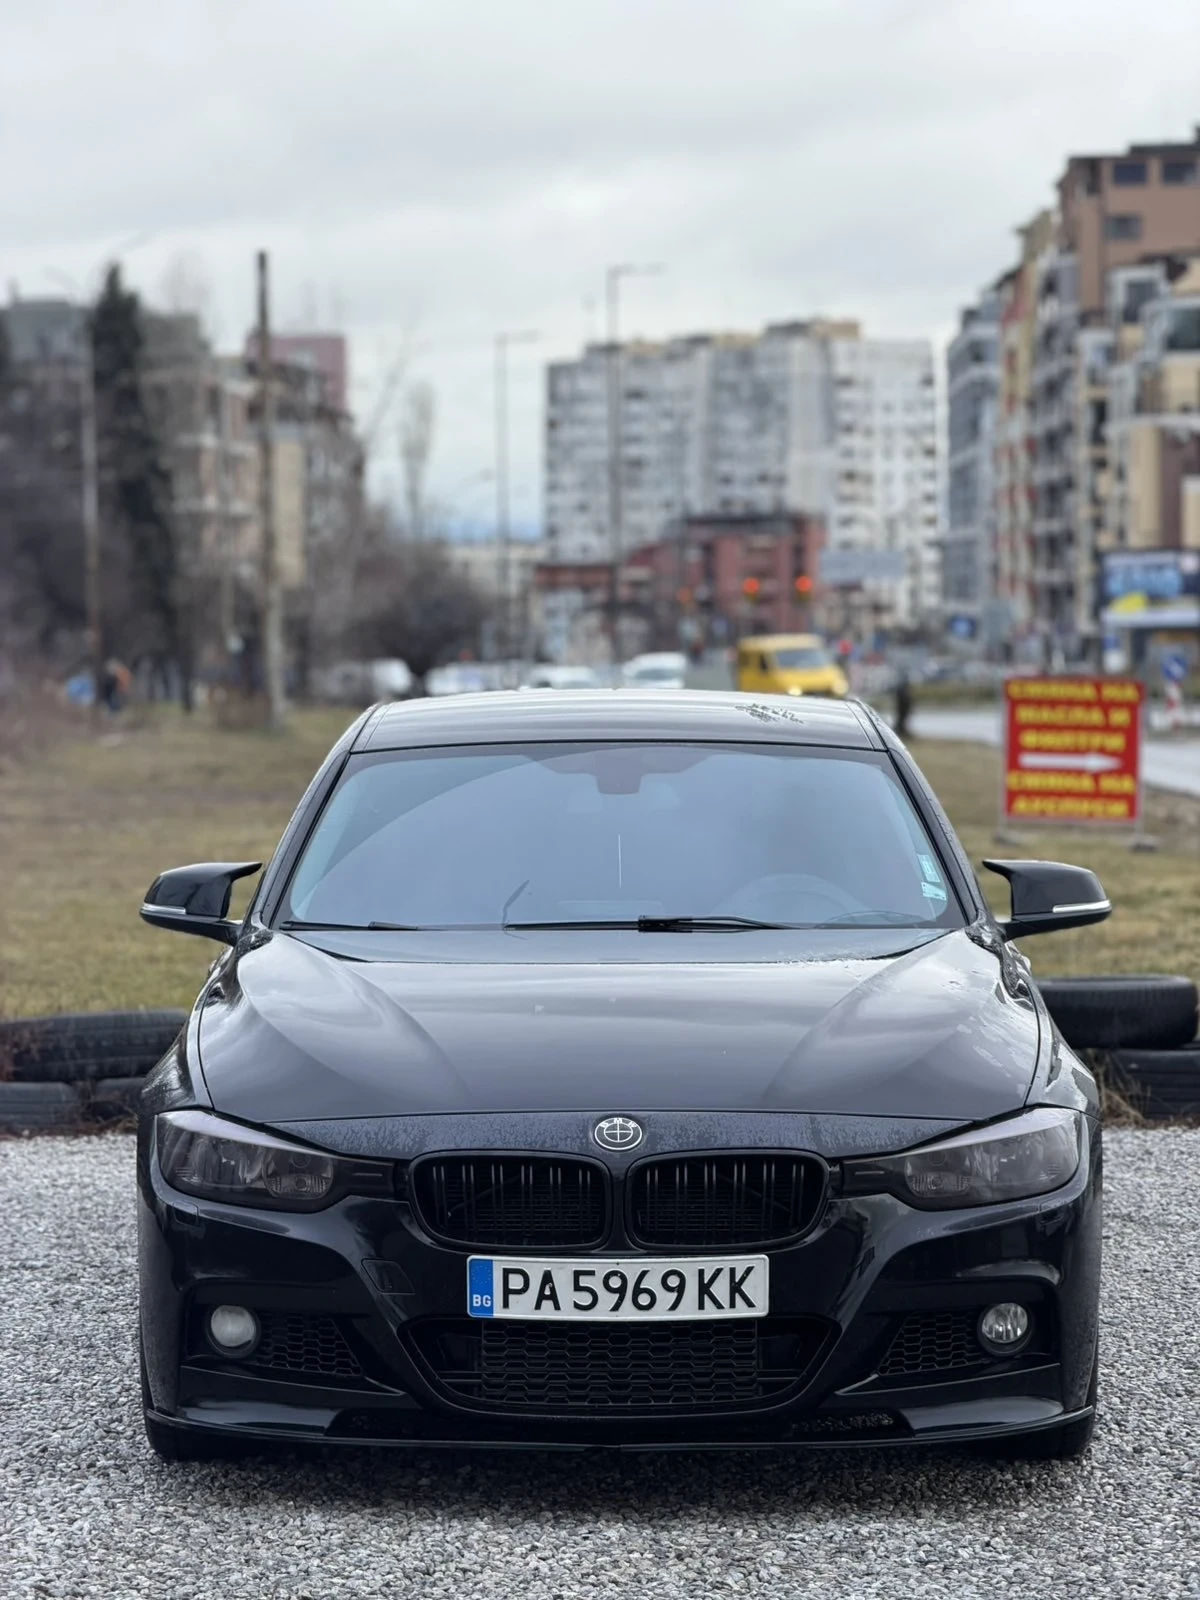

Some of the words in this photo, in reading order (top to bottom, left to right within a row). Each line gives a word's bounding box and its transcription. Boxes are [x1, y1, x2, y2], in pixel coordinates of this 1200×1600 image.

[1101, 683, 1139, 702] НА
[1015, 705, 1105, 726] МАСЛА
[1108, 707, 1131, 728] И
[1019, 729, 1126, 752] ФИЛТРИ
[1099, 774, 1134, 794] НА
[472, 1294, 491, 1307] BG
